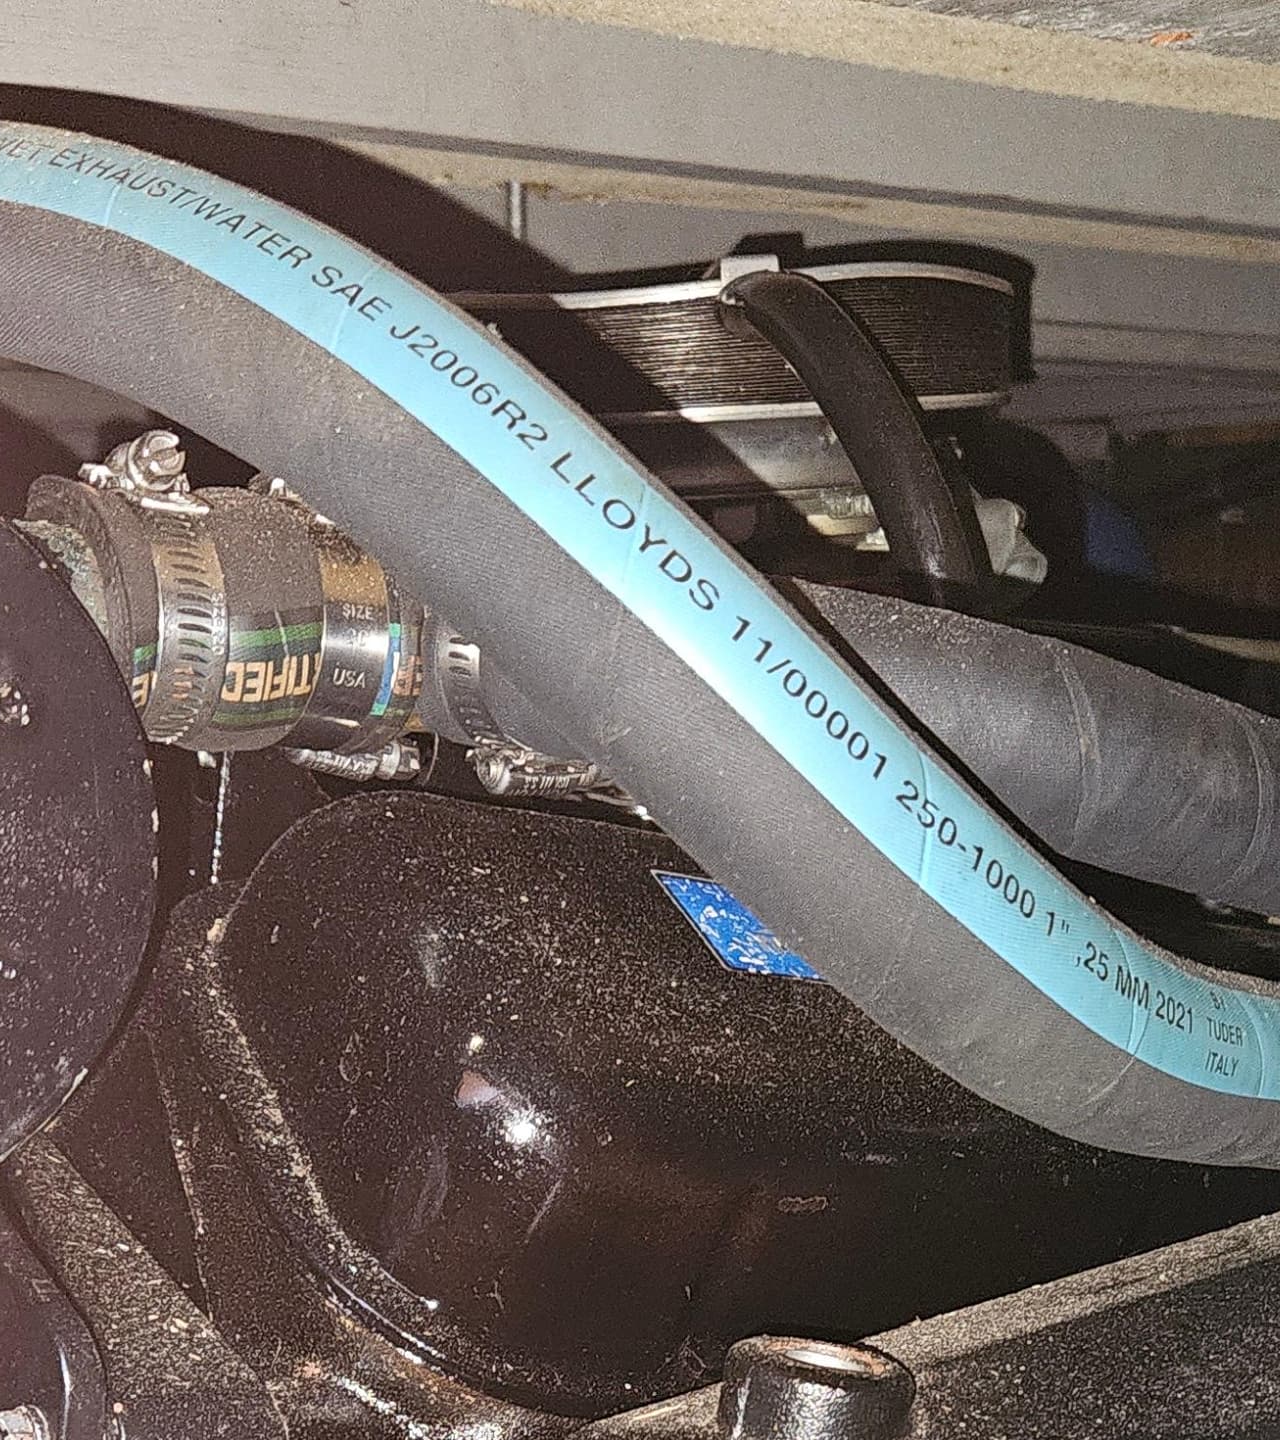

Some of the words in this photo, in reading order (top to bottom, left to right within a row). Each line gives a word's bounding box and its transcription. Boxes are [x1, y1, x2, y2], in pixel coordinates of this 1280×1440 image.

[54, 145, 310, 271] EXHAUST/WATER
[310, 262, 392, 324] SAE
[389, 322, 550, 452] J2006R2
[549, 450, 722, 613] LLOYDS
[729, 613, 887, 783] 11/00001
[896, 777, 1037, 922] 250-1000
[1114, 964, 1150, 1010] MM
[1154, 990, 1194, 1034] 2021
[342, 606, 375, 622] SIZE
[332, 667, 368, 690] USA
[1203, 1052, 1240, 1078] ITALY
